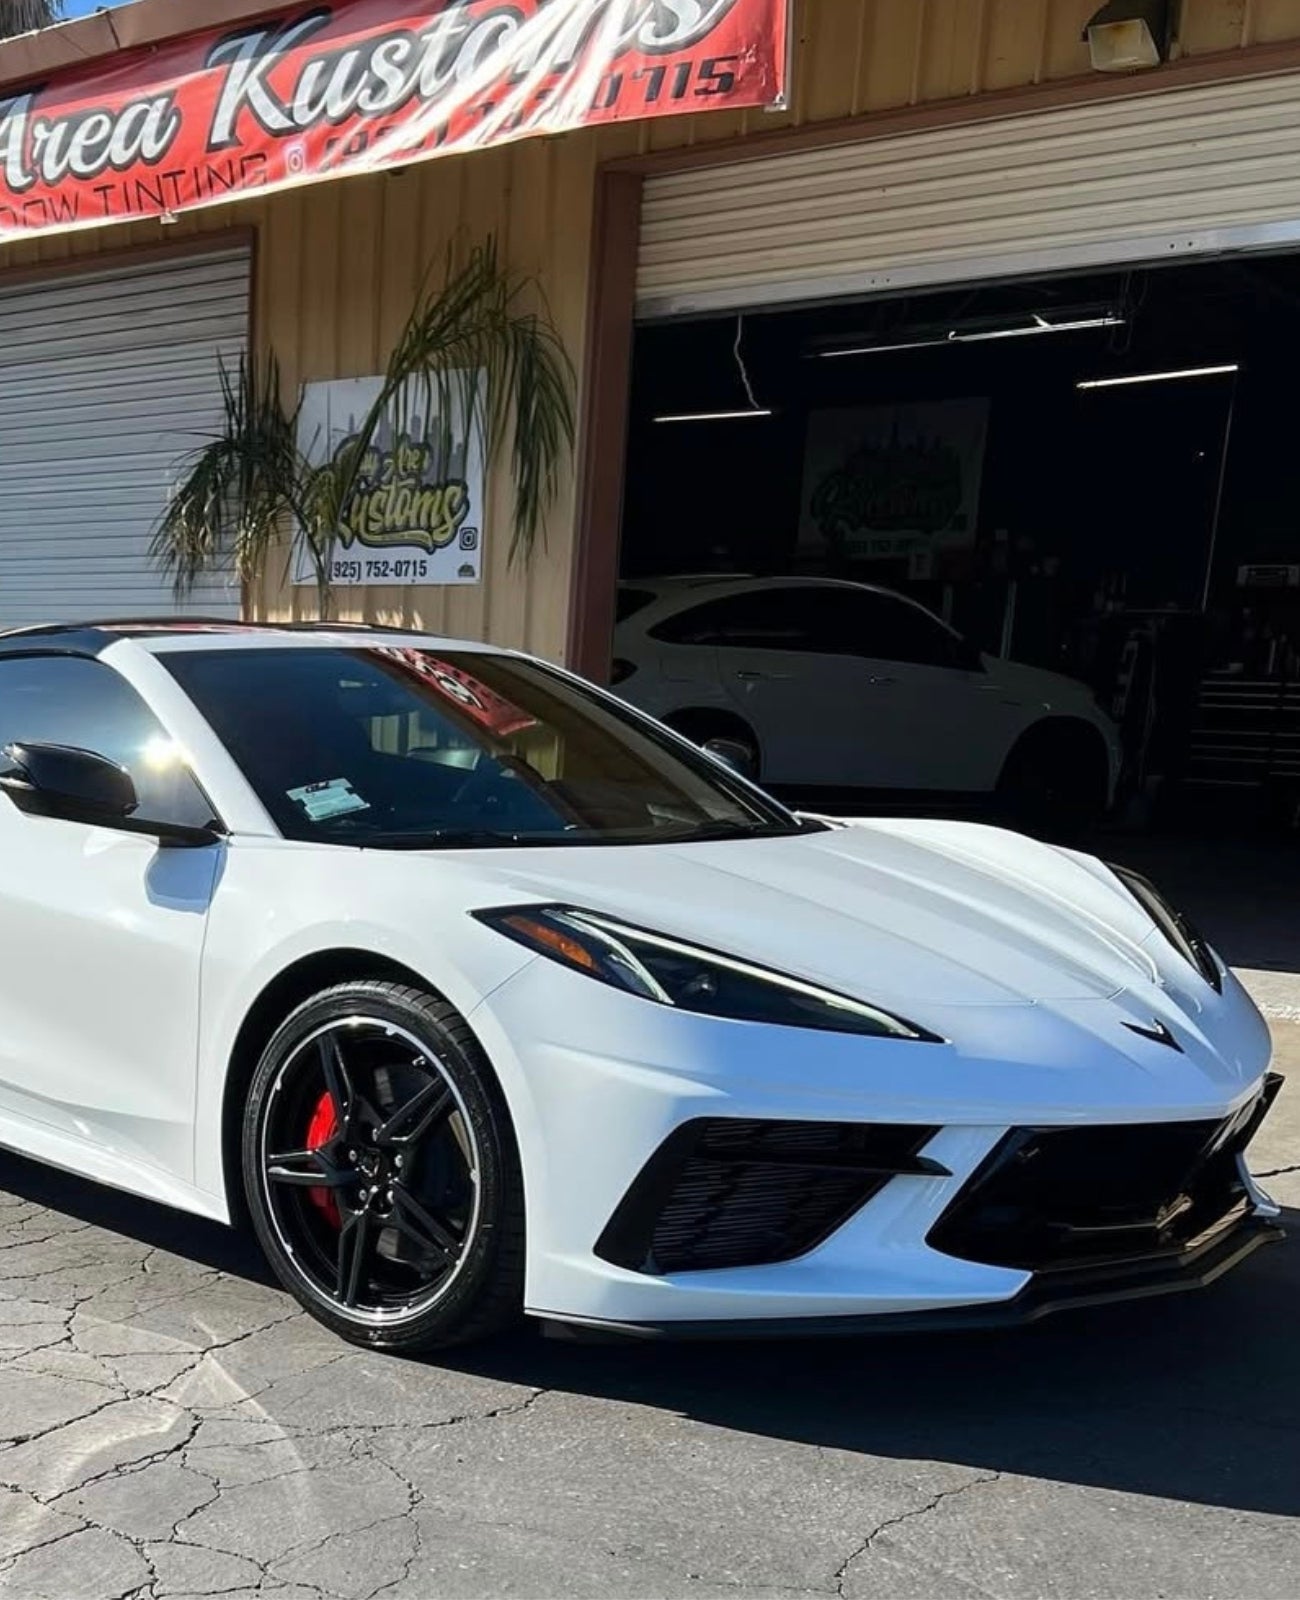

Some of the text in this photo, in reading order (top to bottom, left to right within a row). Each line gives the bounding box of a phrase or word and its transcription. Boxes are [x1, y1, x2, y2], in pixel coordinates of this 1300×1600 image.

[0, 86, 180, 192] Area
[93, 152, 267, 217] TINTING
[366, 559, 428, 577] 752-0715
